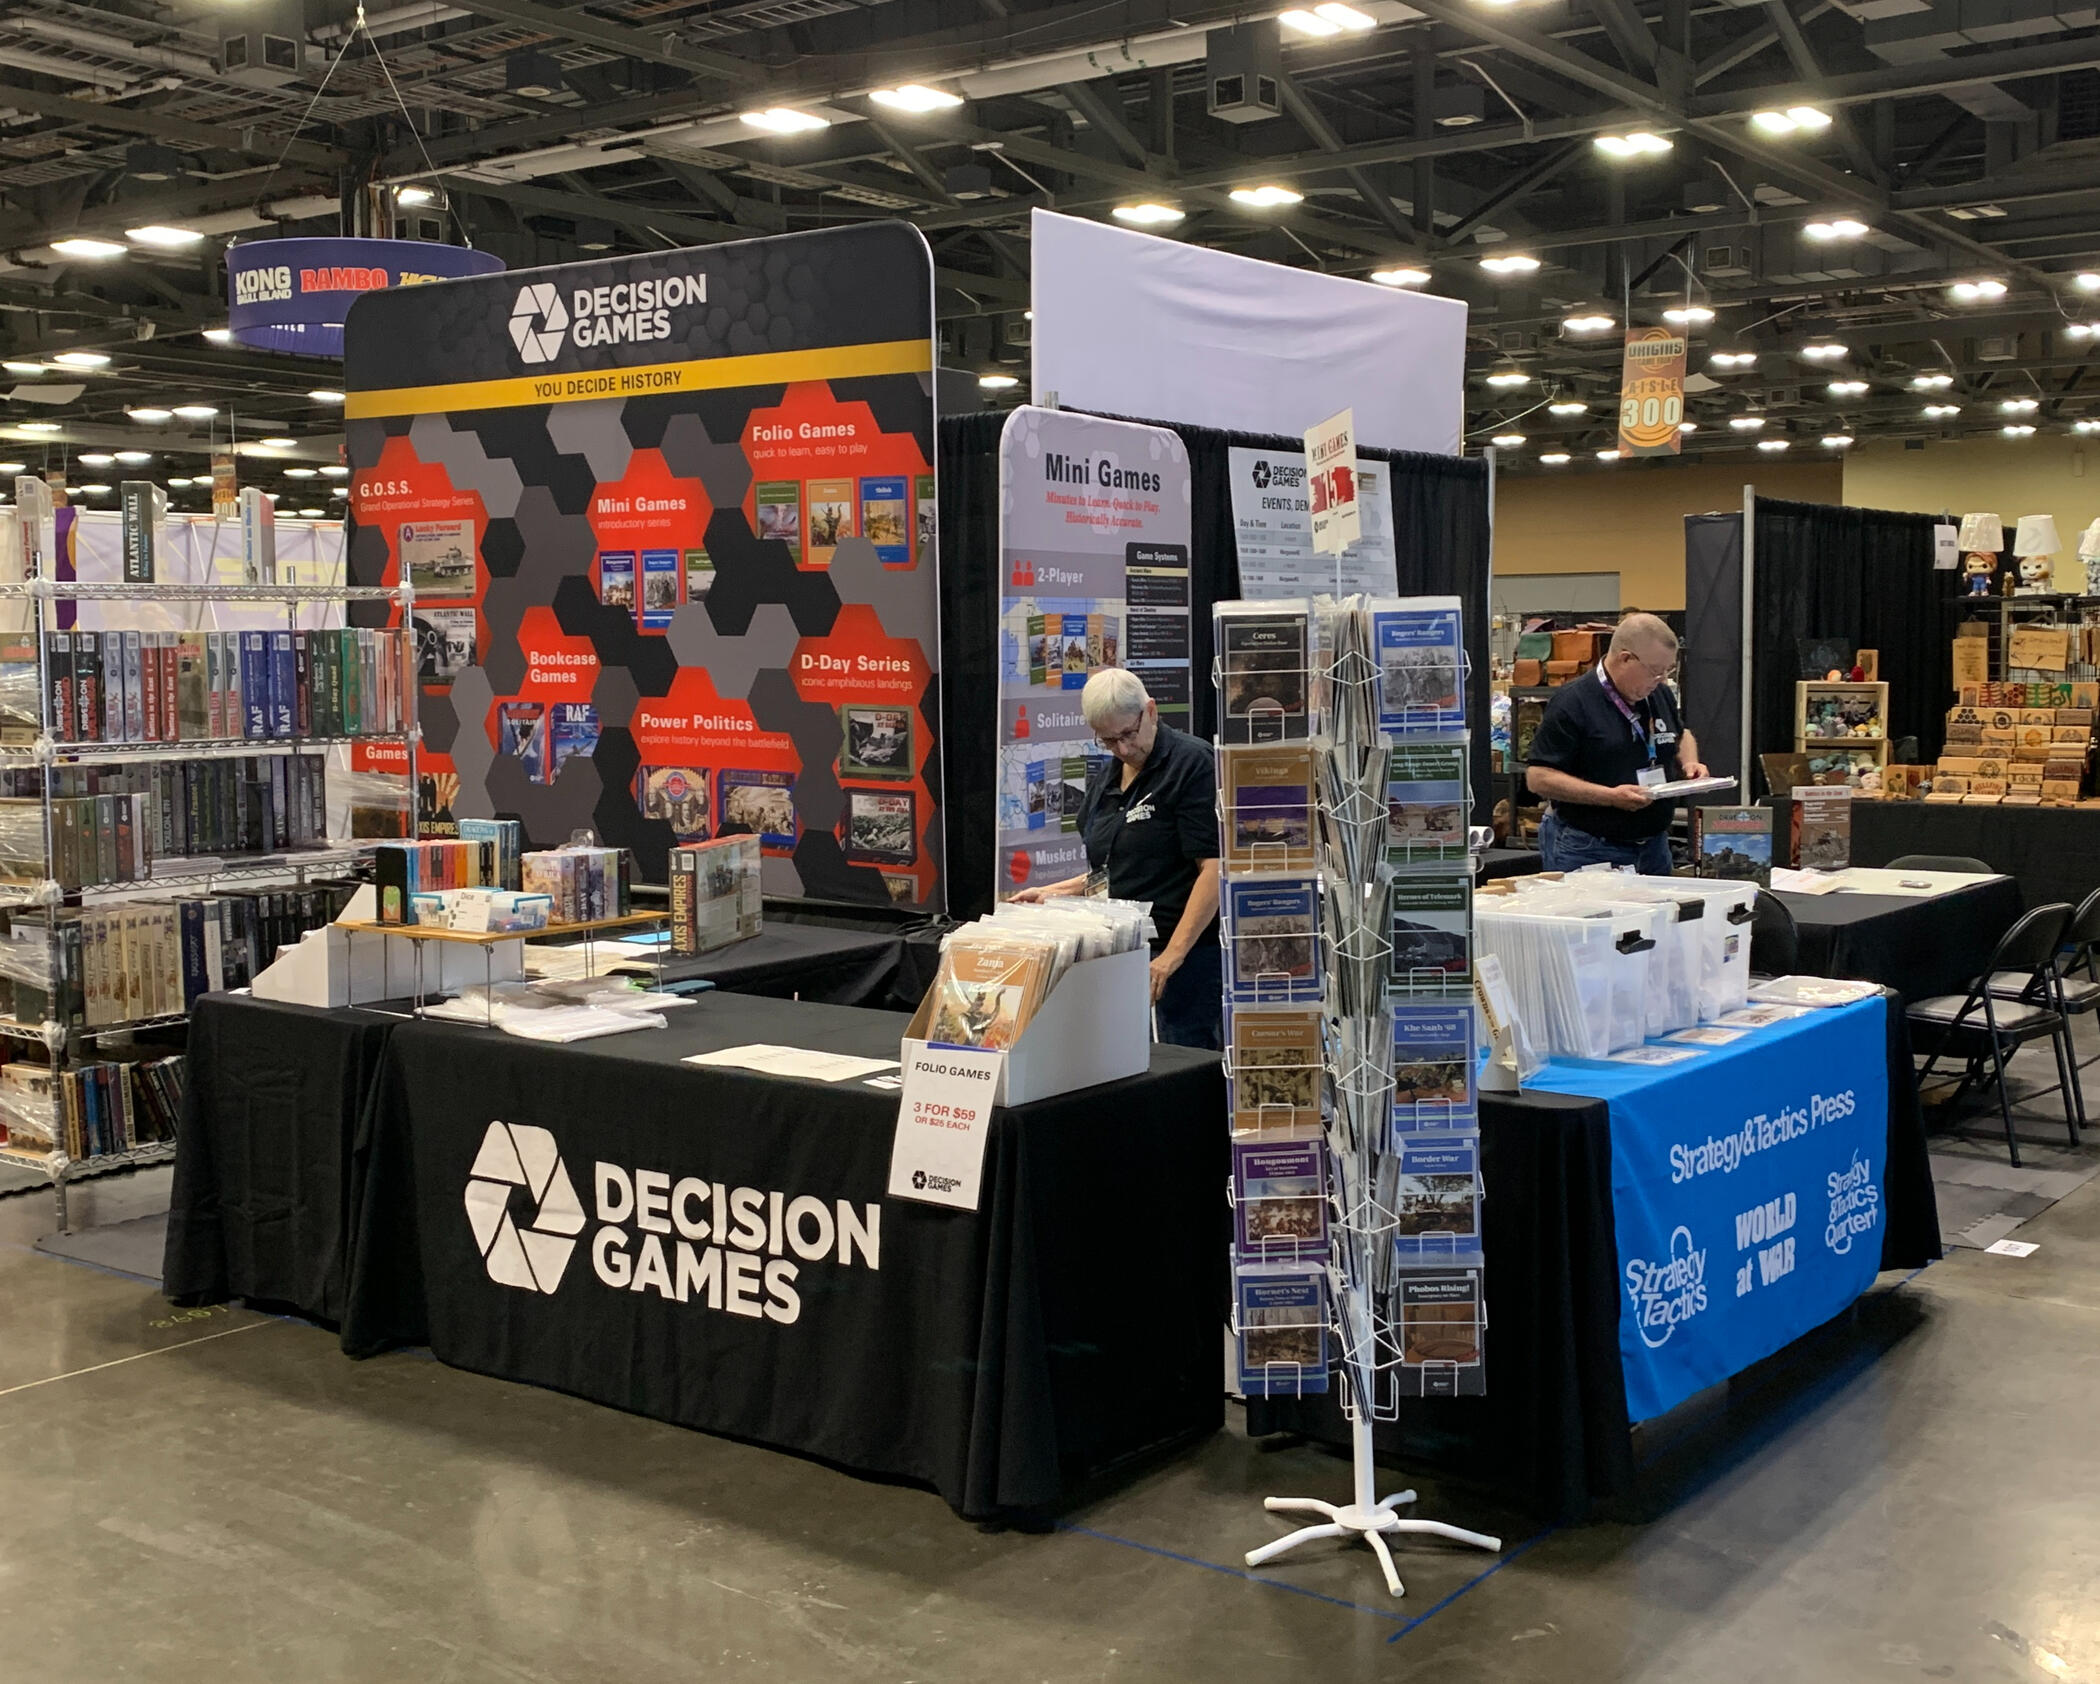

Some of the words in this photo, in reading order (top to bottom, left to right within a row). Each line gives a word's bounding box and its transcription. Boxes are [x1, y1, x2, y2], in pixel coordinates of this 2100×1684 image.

[300, 257, 389, 283] RAMBO
[235, 266, 292, 295] KONG
[573, 273, 707, 319] DECISION
[572, 309, 671, 348] GAMES
[1627, 341, 1683, 358] ORIGINS
[534, 380, 562, 398] YOU
[567, 376, 616, 396] DECIDE
[620, 370, 682, 390] HISTORY
[1628, 378, 1678, 394] AISLE
[1622, 396, 1681, 428] 300
[752, 425, 794, 442] Folio
[799, 422, 857, 440] Games
[1327, 430, 1349, 453] GAMES
[753, 448, 776, 460] quick
[778, 448, 787, 457] to
[788, 446, 813, 458] learn,
[815, 446, 837, 457] easy
[838, 445, 848, 455] to
[849, 443, 869, 455] play
[1045, 452, 1090, 485] Mini
[1097, 459, 1161, 493] Games
[1272, 476, 1300, 488] GAMES
[359, 480, 413, 498] G.O.S.S.
[128, 492, 139, 523] WALL
[597, 498, 630, 513] Mini
[635, 496, 687, 512] Games
[1045, 491, 1077, 507] Minutes
[1079, 495, 1086, 507] to
[1112, 497, 1134, 511] Quick
[1135, 500, 1142, 511] to
[1262, 497, 1294, 512] EVENTS,
[598, 519, 645, 531] introductory
[647, 518, 672, 528] series
[1065, 511, 1110, 528] Historically
[128, 527, 140, 578] ATLANTIC
[1136, 550, 1154, 562] Game
[1154, 551, 1179, 565] Systems
[1037, 566, 1085, 587] 2-Player
[530, 651, 597, 666] Bookcase
[801, 653, 851, 674] D-Day
[857, 655, 911, 672] Series
[530, 668, 577, 683] Games
[801, 677, 826, 688] iconic
[827, 676, 876, 692] amphibious
[877, 677, 913, 691] landings
[250, 706, 264, 734] RAF
[278, 705, 292, 733] RAF
[565, 704, 591, 722] RAF
[640, 713, 689, 728] Power
[693, 715, 754, 731] Politics
[1036, 711, 1086, 729] Solitaire
[641, 735, 670, 746] explore
[671, 735, 700, 747] history
[701, 736, 730, 748] beyond
[733, 737, 746, 747] the
[365, 745, 409, 761] Games
[1035, 847, 1077, 867] Musket
[461, 891, 475, 901] Dice
[672, 874, 688, 923] EMPIRES
[673, 925, 688, 952] AXIS
[915, 1061, 948, 1075] FOLIO
[949, 1065, 991, 1081] GAMES
[913, 1102, 921, 1113] 3
[925, 1103, 950, 1117] FOR
[953, 1106, 976, 1121] $59
[1810, 1089, 1856, 1131] Press
[915, 1115, 928, 1125] OR
[946, 1120, 970, 1131] EACH
[927, 1181, 952, 1193] GAMES
[928, 1174, 962, 1188] DECISION
[595, 1160, 881, 1271] DECISION
[1735, 1192, 1797, 1251] WORLD
[592, 1225, 801, 1325] GAMES
[1735, 1257, 1753, 1298] at
[1758, 1237, 1796, 1287] WAR
[1408, 1284, 1440, 1293] Phobos
[1638, 1281, 1708, 1328] Tactics
